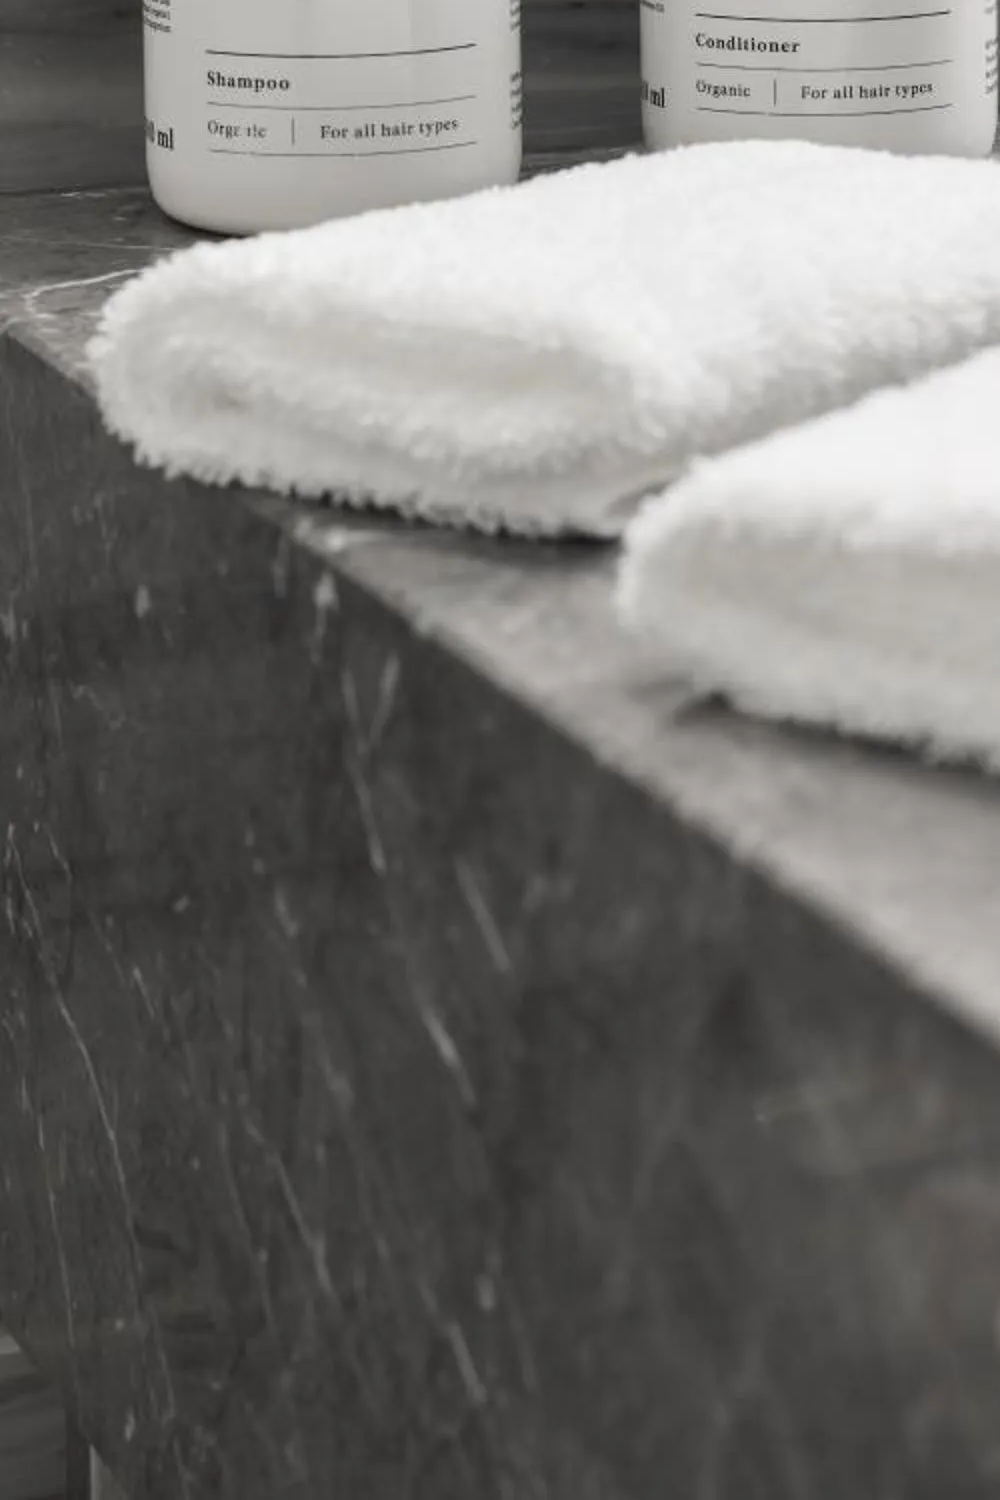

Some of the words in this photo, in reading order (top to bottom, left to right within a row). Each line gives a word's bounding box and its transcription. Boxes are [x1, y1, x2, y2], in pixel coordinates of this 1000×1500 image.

[696, 33, 800, 52] Conditioner
[207, 70, 291, 93] Shampoo
[696, 80, 750, 98] Organic
[799, 85, 829, 100] For
[834, 86, 853, 99] all
[859, 85, 890, 98] hair
[896, 84, 932, 98] types
[321, 126, 348, 139] For
[354, 124, 375, 138] all
[381, 123, 414, 137] hair
[419, 120, 458, 137] types
